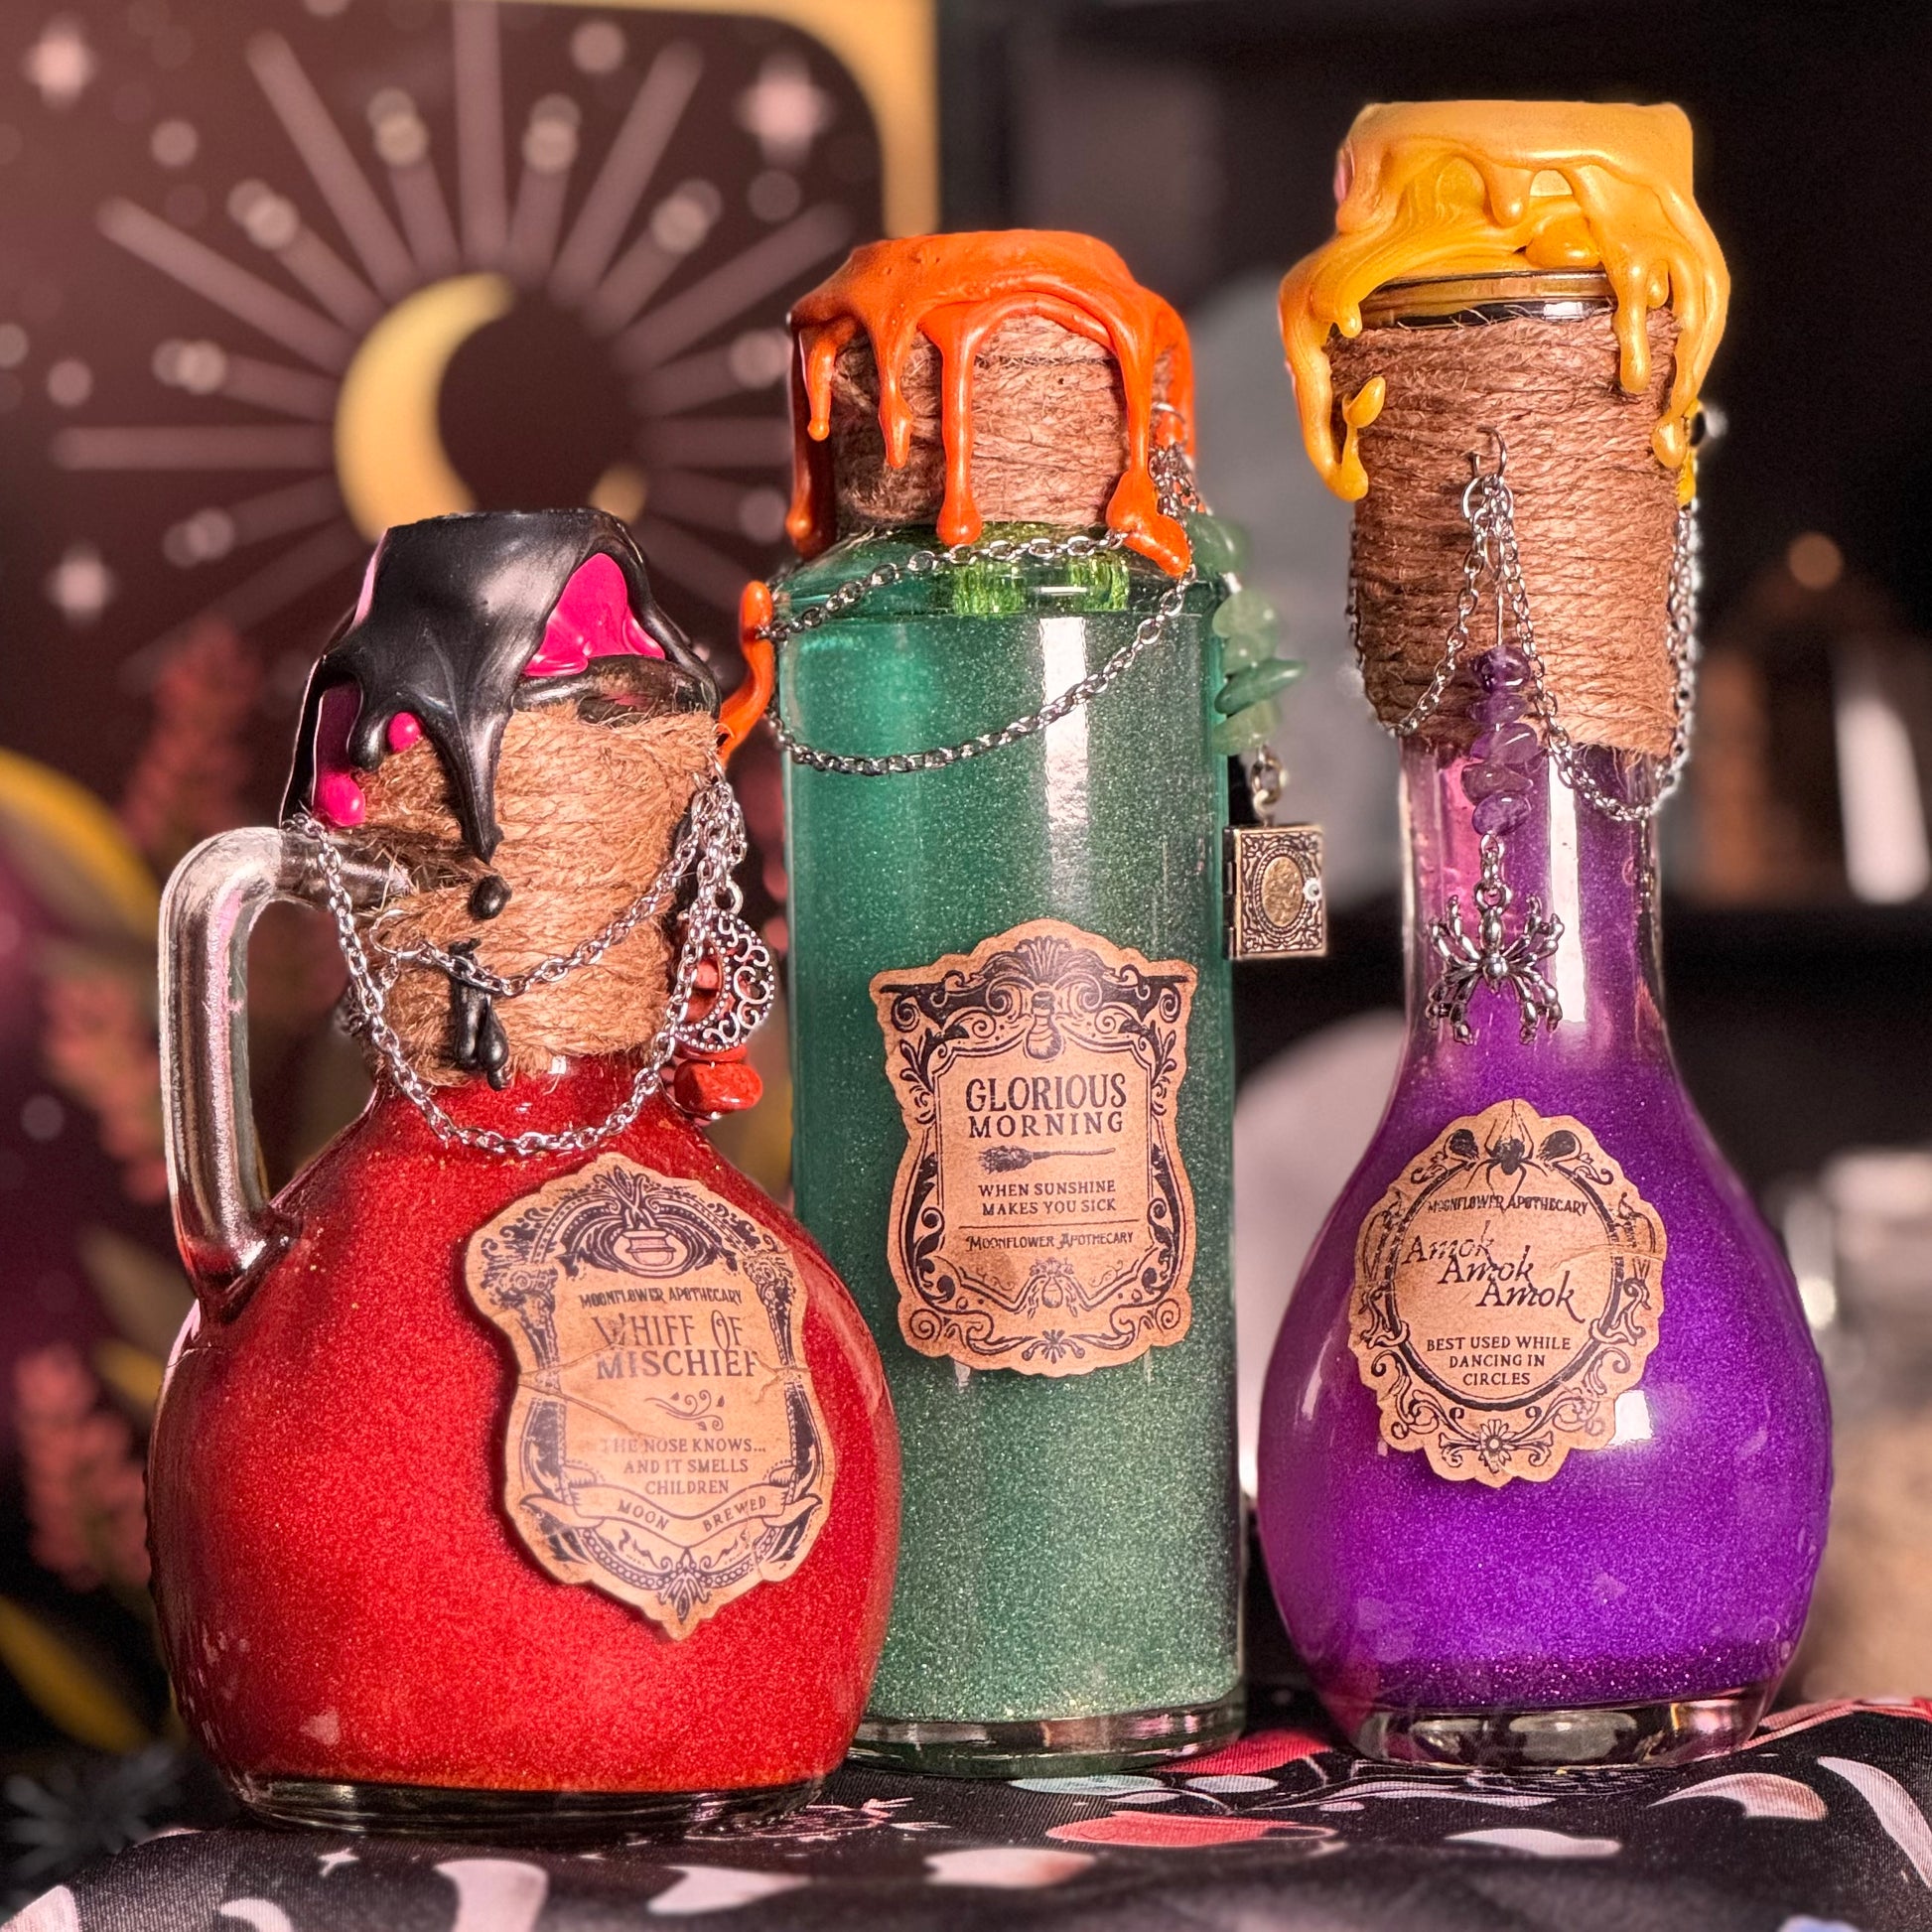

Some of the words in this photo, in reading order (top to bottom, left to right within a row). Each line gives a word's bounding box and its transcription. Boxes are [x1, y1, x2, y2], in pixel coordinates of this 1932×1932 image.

[965, 1072, 1127, 1112] GLORIOUS
[968, 1111, 1123, 1139] MORNING
[978, 1182, 1030, 1197] WHEN
[1034, 1179, 1116, 1195] SUNSHINE
[982, 1201, 1038, 1216] MAKES
[1042, 1199, 1076, 1213] YOU
[1080, 1197, 1117, 1212] SICK
[1506, 1194, 1588, 1217] APOTHECARY
[1438, 1245, 1542, 1295] Amok
[579, 1288, 665, 1309] MOONFLOWER
[668, 1286, 743, 1306] APOTHECARY
[1475, 1270, 1586, 1324] Amok
[591, 1311, 696, 1347] WHIFF
[711, 1309, 744, 1351] OF
[1427, 1336, 1465, 1352] BEST
[1470, 1335, 1511, 1349] USED
[1515, 1335, 1571, 1350] WHILE
[596, 1349, 758, 1380] MISCHIEF
[1449, 1353, 1522, 1369] DANCING
[1527, 1353, 1546, 1367] IN
[1462, 1372, 1531, 1386] CIRCLES
[602, 1439, 639, 1453] THE
[644, 1438, 688, 1452] NOSE
[622, 1458, 660, 1474] AND
[665, 1458, 683, 1473] IT
[688, 1457, 749, 1473] SMELLS
[645, 1479, 730, 1495] CHILDREN
[617, 1498, 670, 1532] MOON
[702, 1495, 766, 1533] BREWED
